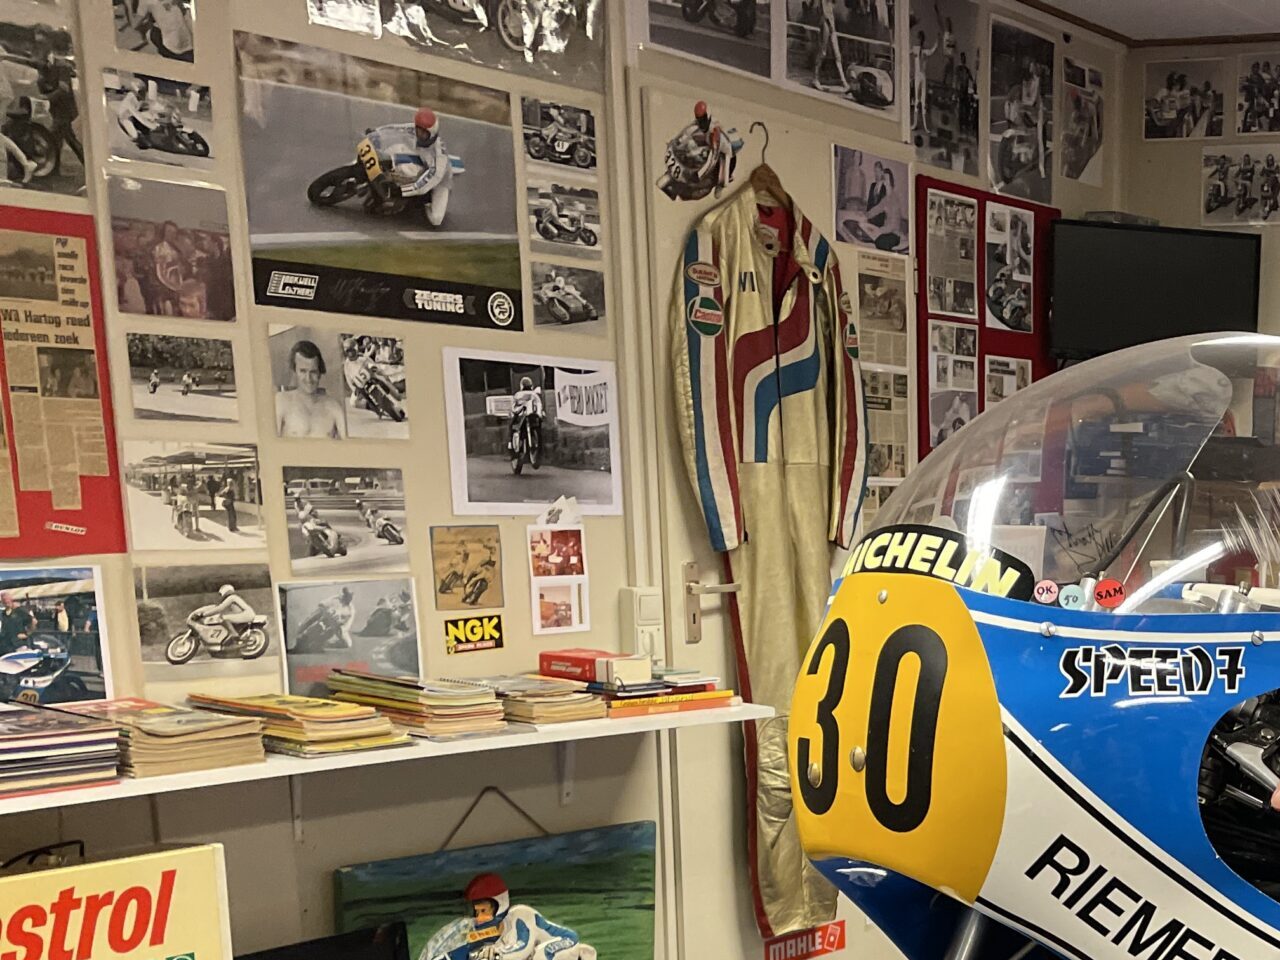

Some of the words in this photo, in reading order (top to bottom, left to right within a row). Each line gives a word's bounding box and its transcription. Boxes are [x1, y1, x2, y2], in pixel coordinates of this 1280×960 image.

[415, 290, 463, 304] ZEGERS
[416, 302, 464, 314] TUNING
[24, 310, 61, 327] Hartog
[55, 332, 79, 344] zoek
[1096, 586, 1124, 600] SAM
[447, 617, 501, 642] NGK
[797, 618, 948, 833] 30
[469, 927, 498, 941] Shell
